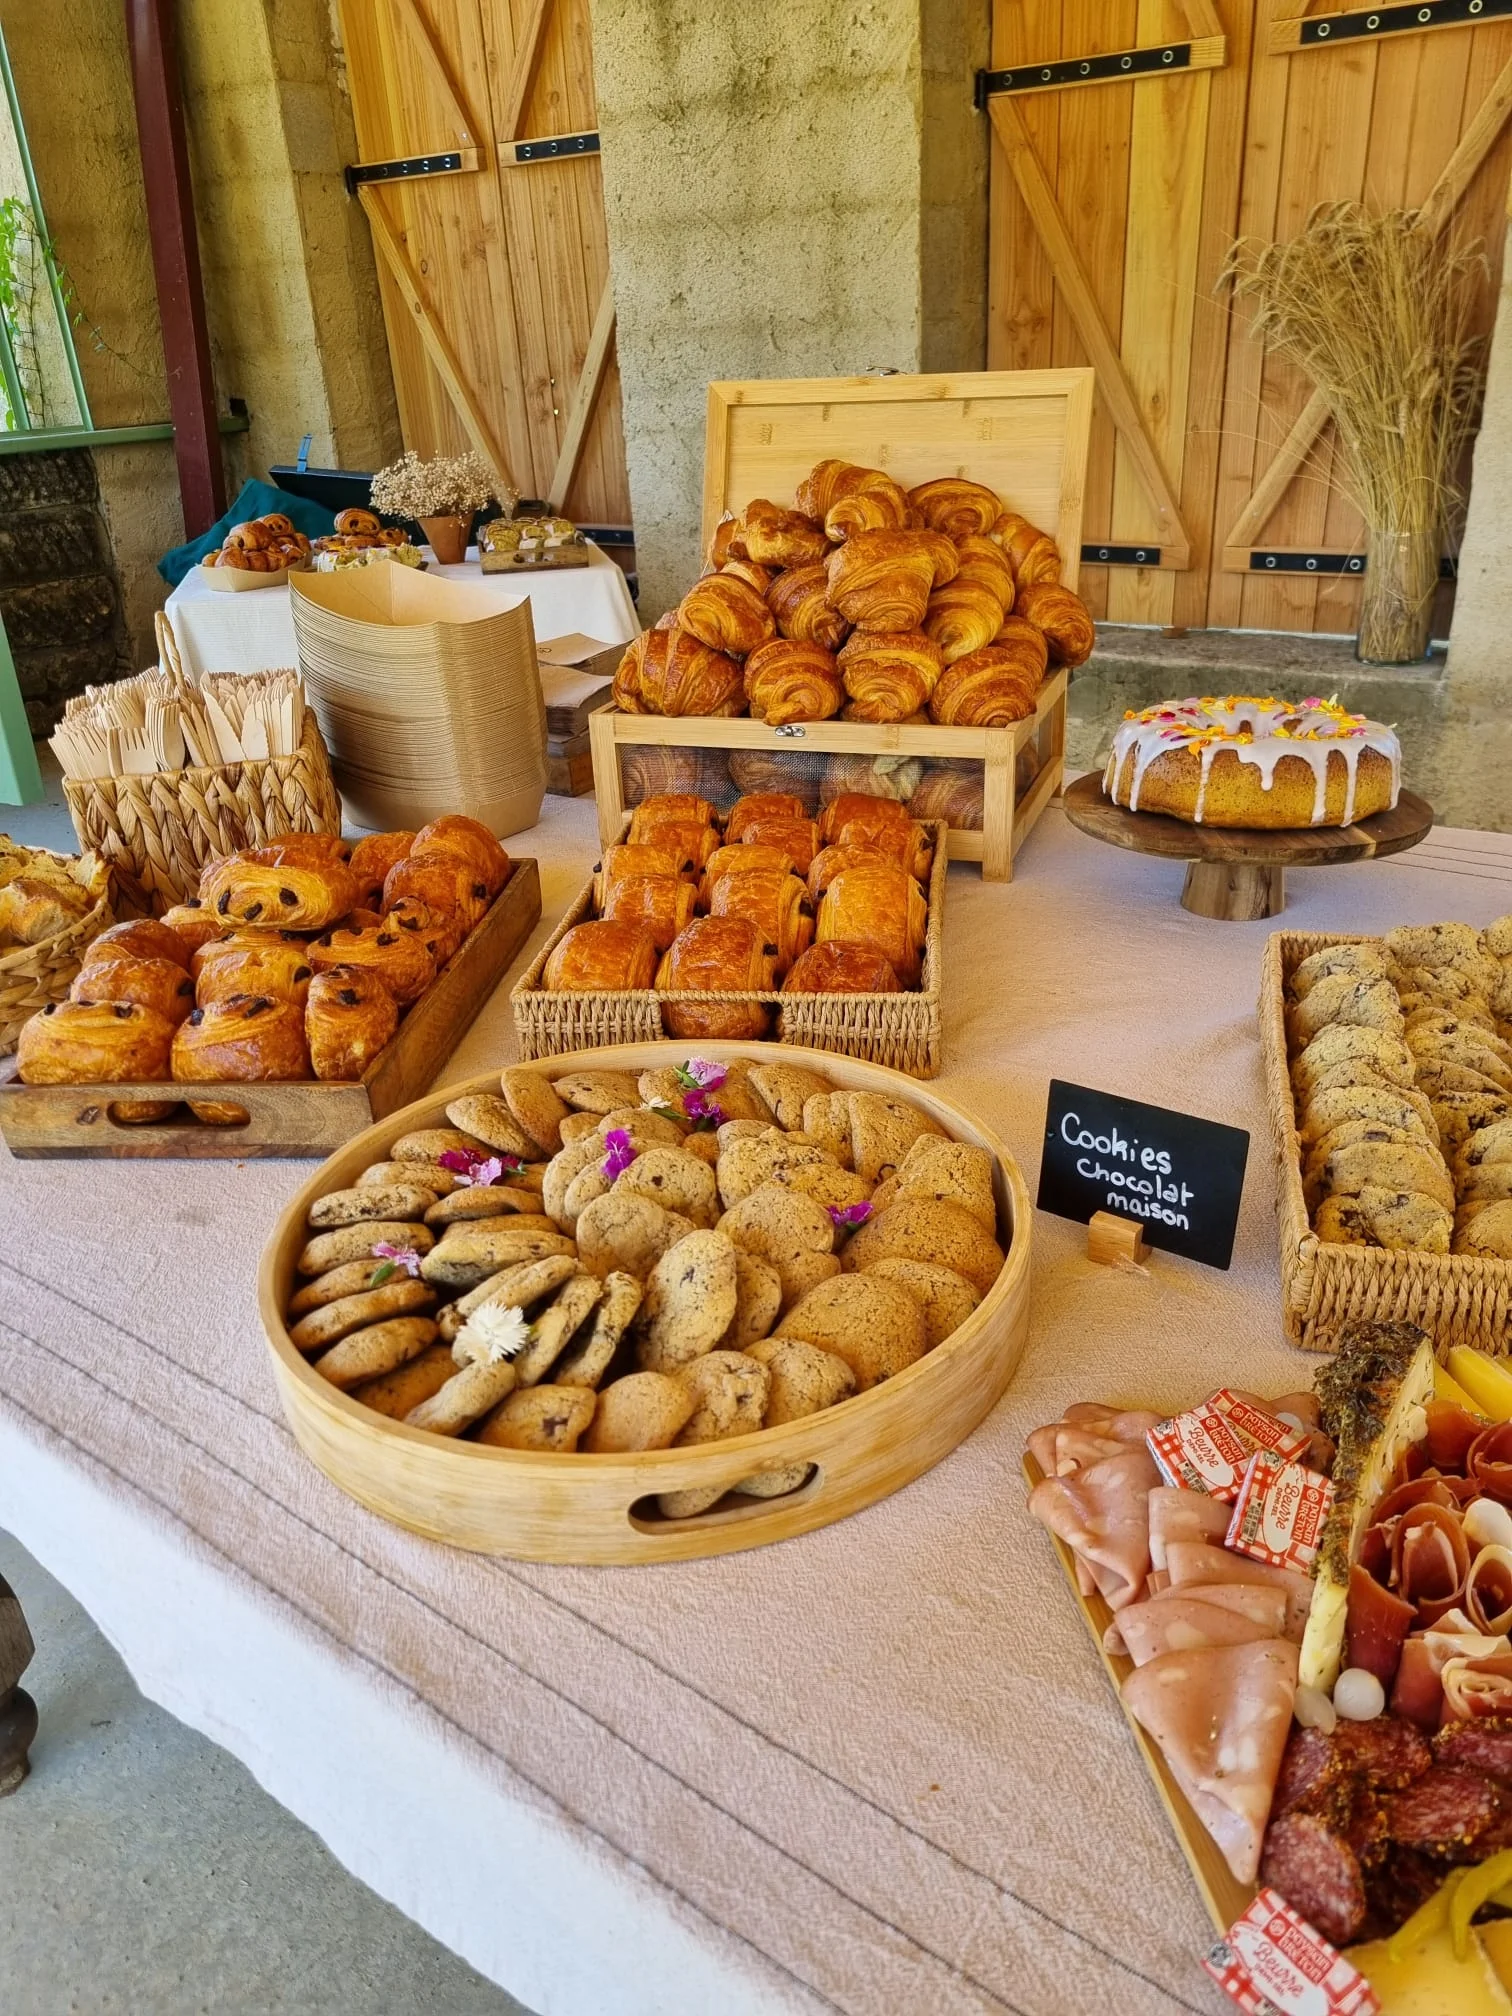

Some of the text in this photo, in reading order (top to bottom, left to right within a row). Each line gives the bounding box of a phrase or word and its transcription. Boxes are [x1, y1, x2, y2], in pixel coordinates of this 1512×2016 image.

[1061, 1112, 1172, 1175] Cookies
[1076, 1158, 1194, 1207] Chocolat
[1107, 1192, 1189, 1230] maison
[1208, 1428, 1235, 1462] BRETON
[1216, 1425, 1244, 1458] paysan
[1239, 1417, 1273, 1445] BRETON
[1244, 1411, 1279, 1439] paysan
[1189, 1427, 1219, 1468] Beurre
[1270, 1487, 1282, 1517] DEMI-SEL
[1275, 1483, 1300, 1530] Beurre
[1292, 1499, 1310, 1539] BRETON
[1303, 1503, 1318, 1543] paysan
[1277, 1936, 1322, 1981] BRETON
[1285, 1926, 1331, 1970] paysan
[1254, 1942, 1304, 1996] Beurre
